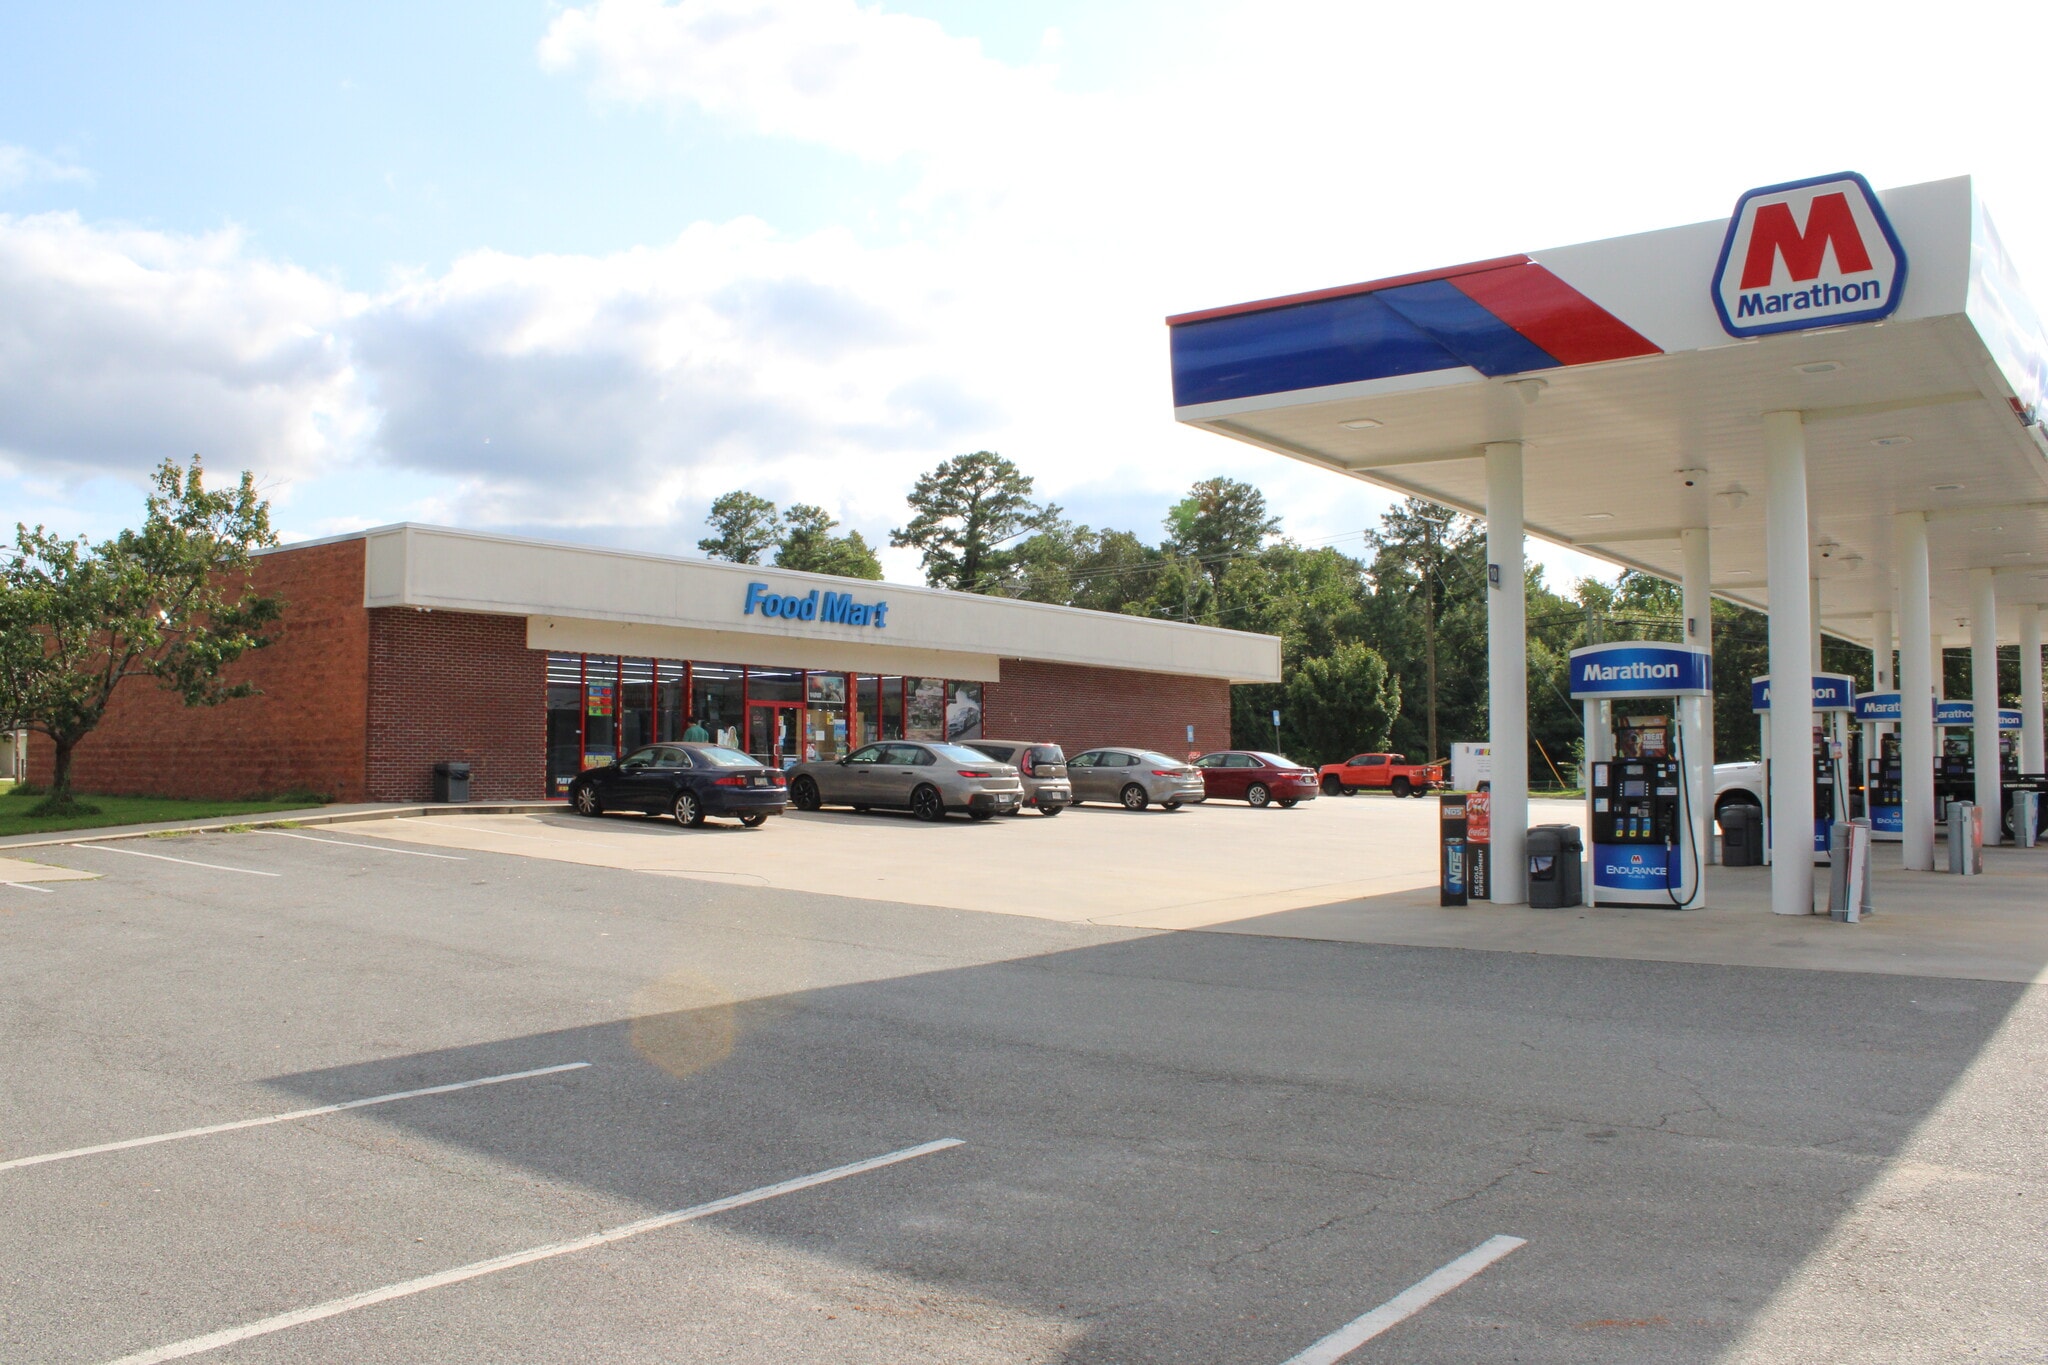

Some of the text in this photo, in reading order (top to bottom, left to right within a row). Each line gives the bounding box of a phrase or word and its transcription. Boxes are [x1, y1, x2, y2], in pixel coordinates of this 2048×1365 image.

[1740, 191, 1873, 290] M
[1737, 279, 1880, 318] Marathon
[744, 582, 888, 628] Food Mart
[1583, 662, 1679, 681] Marathon
[1864, 702, 1902, 713] Marat
[1444, 806, 1464, 816] NOS
[1448, 848, 1463, 885] NOS
[1606, 865, 1667, 875] ENDURANCE
